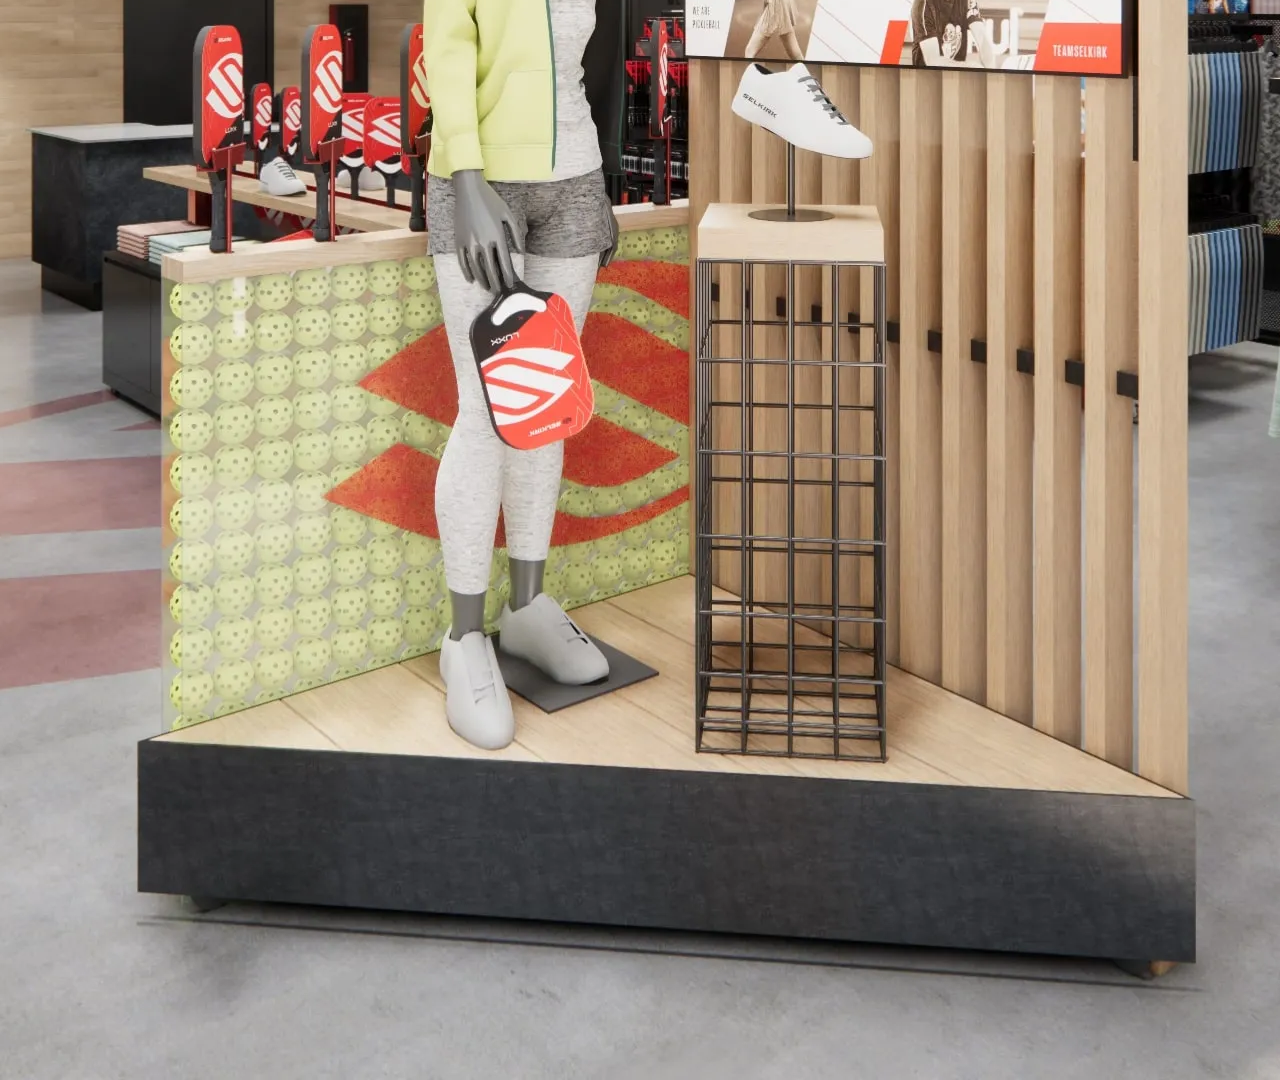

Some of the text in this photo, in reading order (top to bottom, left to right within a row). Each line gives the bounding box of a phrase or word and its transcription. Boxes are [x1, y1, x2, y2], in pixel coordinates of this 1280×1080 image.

[1052, 44, 1108, 58] TEAMSELKIRK
[743, 92, 778, 119] SELKIRK
[491, 331, 521, 347] LUXX
